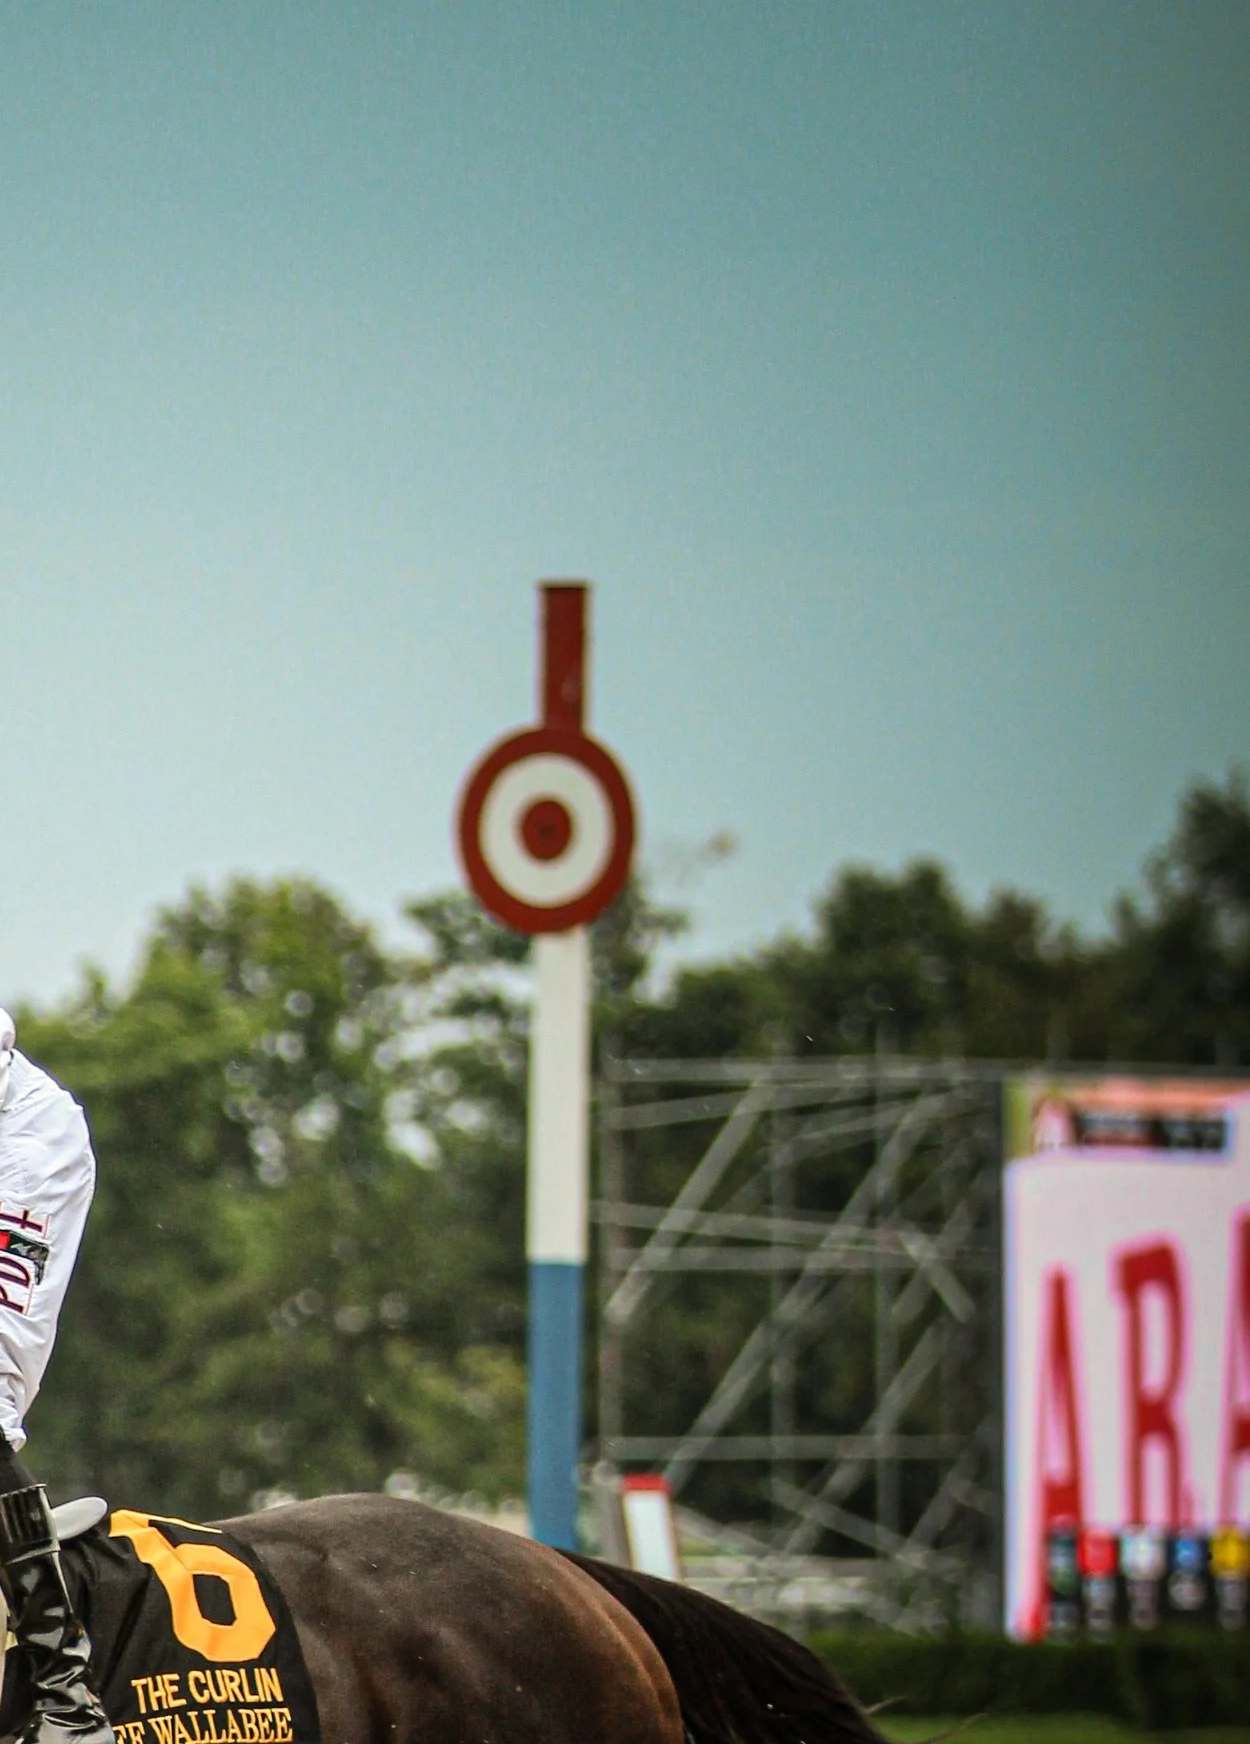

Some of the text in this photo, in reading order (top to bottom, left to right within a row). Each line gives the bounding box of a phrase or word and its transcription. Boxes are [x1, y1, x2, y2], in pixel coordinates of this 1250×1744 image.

[108, 1508, 277, 1663] 6
[130, 1667, 285, 1715] THE CURLIN
